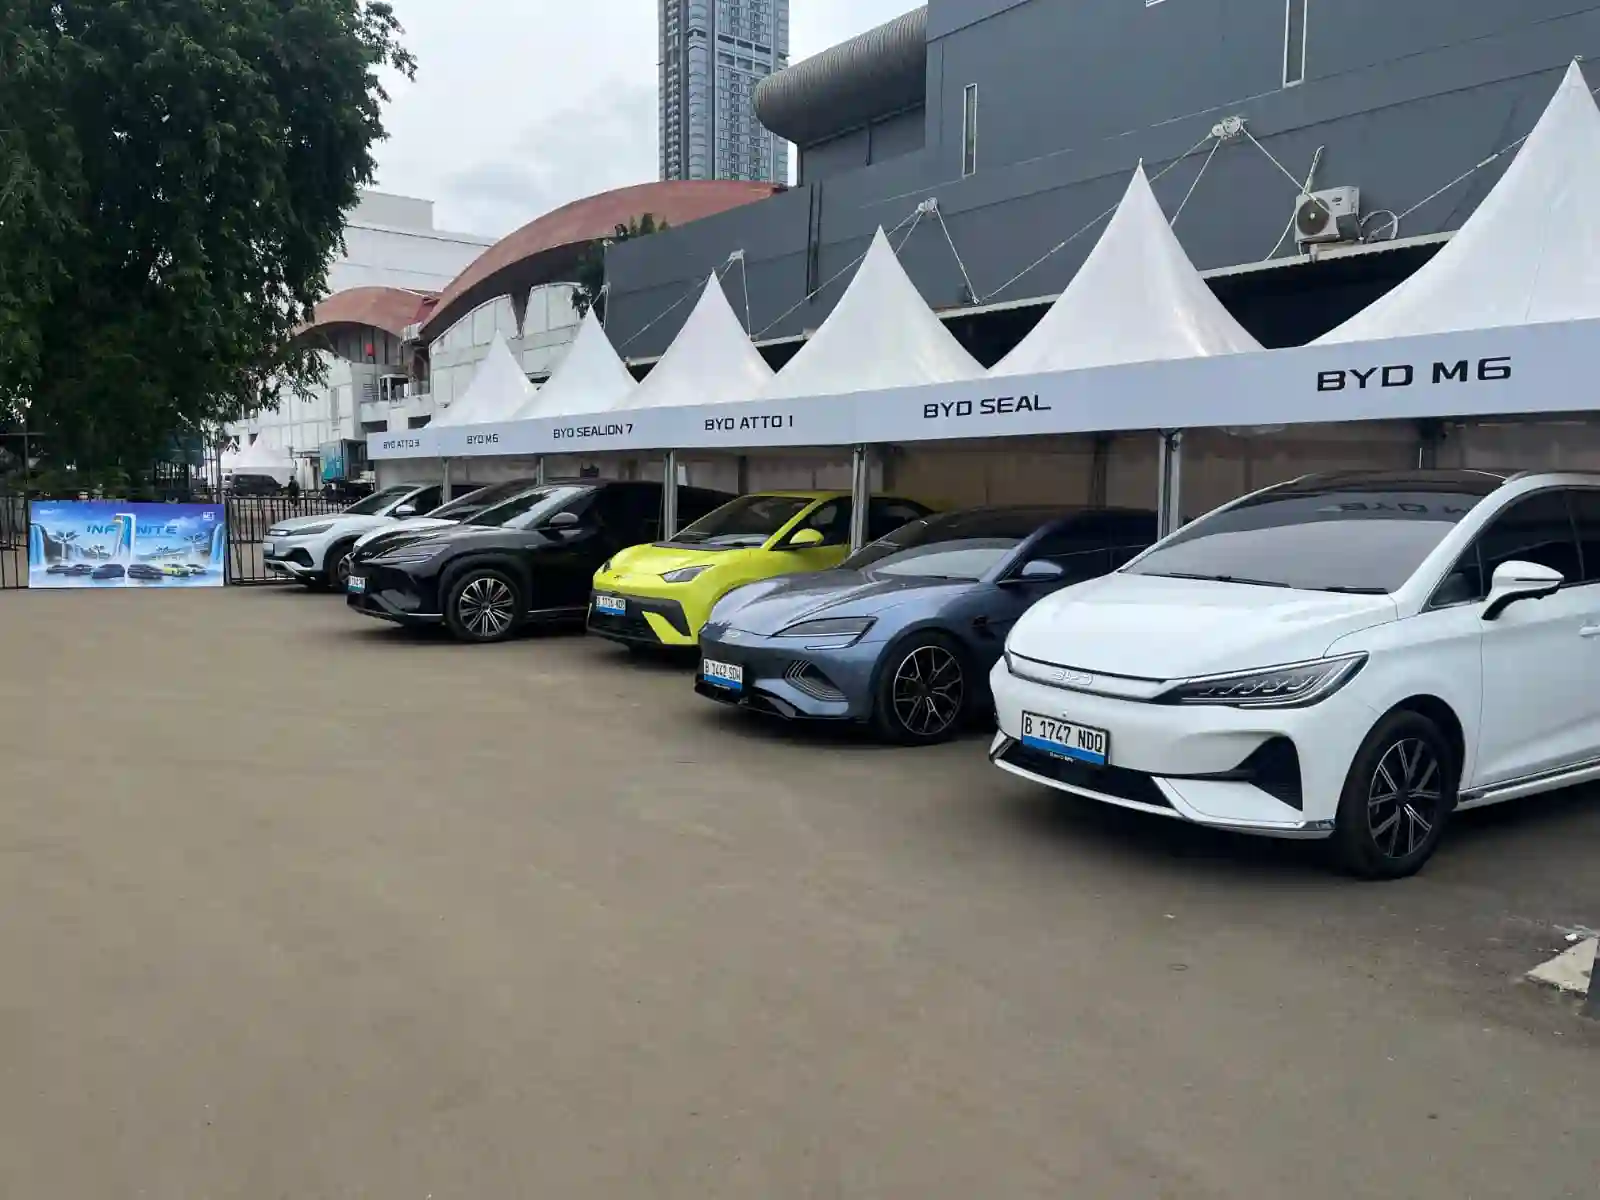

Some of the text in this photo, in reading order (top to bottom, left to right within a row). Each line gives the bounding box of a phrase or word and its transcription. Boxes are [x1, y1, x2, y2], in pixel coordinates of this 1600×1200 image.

[1317, 356, 1512, 392] BYD M6
[923, 394, 1052, 419] BYD SEAL
[553, 423, 633, 439] BYD SEALION 7
[704, 415, 793, 431] BYD ATTO 1
[466, 433, 499, 445] BYD M6
[705, 661, 709, 673] B
[1025, 717, 1103, 752] B 1747 NDQ
